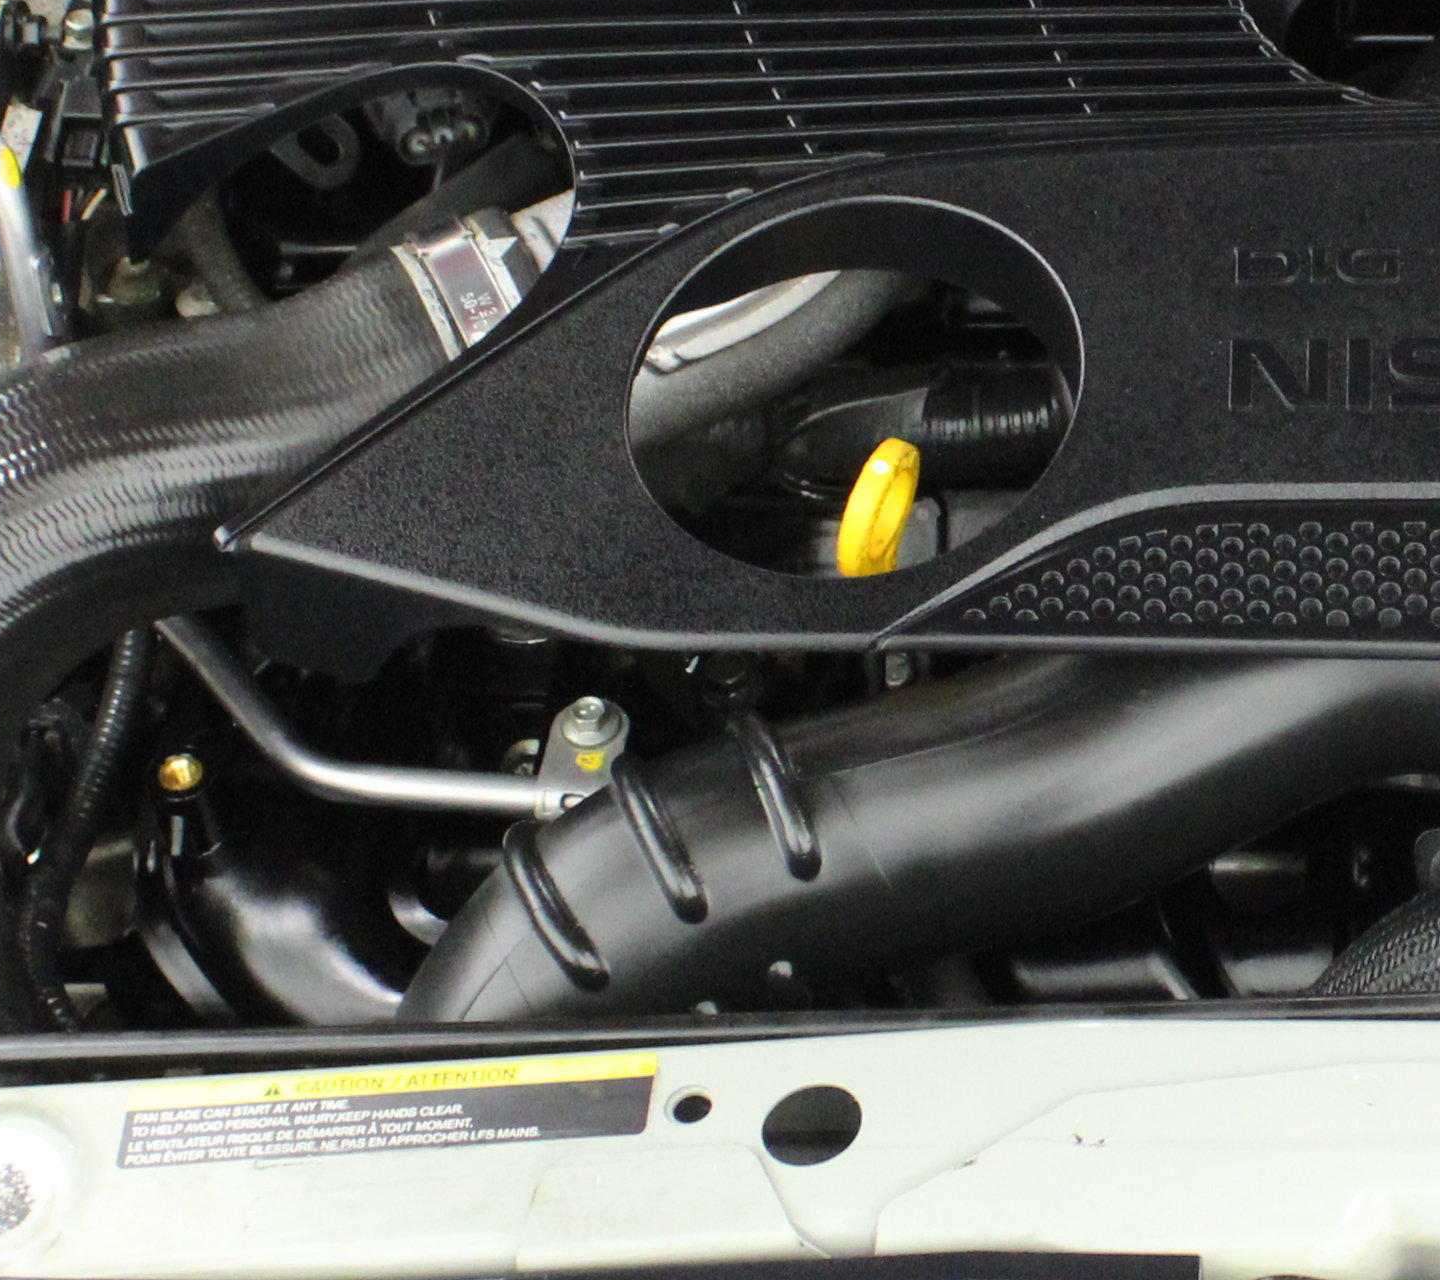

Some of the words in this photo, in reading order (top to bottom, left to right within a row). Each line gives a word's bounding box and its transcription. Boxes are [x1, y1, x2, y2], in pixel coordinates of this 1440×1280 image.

[1231, 244, 1405, 287] DIG
[295, 1076, 385, 1095] CAUTION
[407, 1066, 519, 1088] ATTENTION
[131, 1125, 150, 1137] TO
[150, 1123, 184, 1136] HELP
[184, 1120, 223, 1133] AVOID
[224, 1116, 292, 1131] PERSONAL
[372, 1106, 418, 1119] HANDS
[419, 1104, 464, 1116] CLEAR.
[133, 1111, 158, 1124] FAN
[160, 1109, 201, 1122] BLADE
[202, 1107, 230, 1119] CAN
[231, 1104, 272, 1117] START
[273, 1102, 289, 1114] AT
[290, 1100, 320, 1113] ANY
[124, 1153, 162, 1166] POUR
[162, 1147, 206, 1163] ÉVITER
[207, 1145, 248, 1159] TOUTE
[319, 1137, 339, 1150] NE
[340, 1136, 366, 1149] PAS
[367, 1135, 386, 1148] EN
[387, 1129, 469, 1147] APPROCHER
[470, 1129, 495, 1141] LES
[496, 1126, 541, 1139] MAINS.
[127, 1141, 144, 1152] LE
[145, 1133, 225, 1151] VENTILATEUR
[226, 1130, 275, 1145] RISQUE
[276, 1127, 295, 1140] DE
[296, 1122, 367, 1139] DÉMARRER
[368, 1118, 379, 1134] À
[379, 1120, 413, 1134] TOUT
[414, 1117, 474, 1132] MOMENT.
